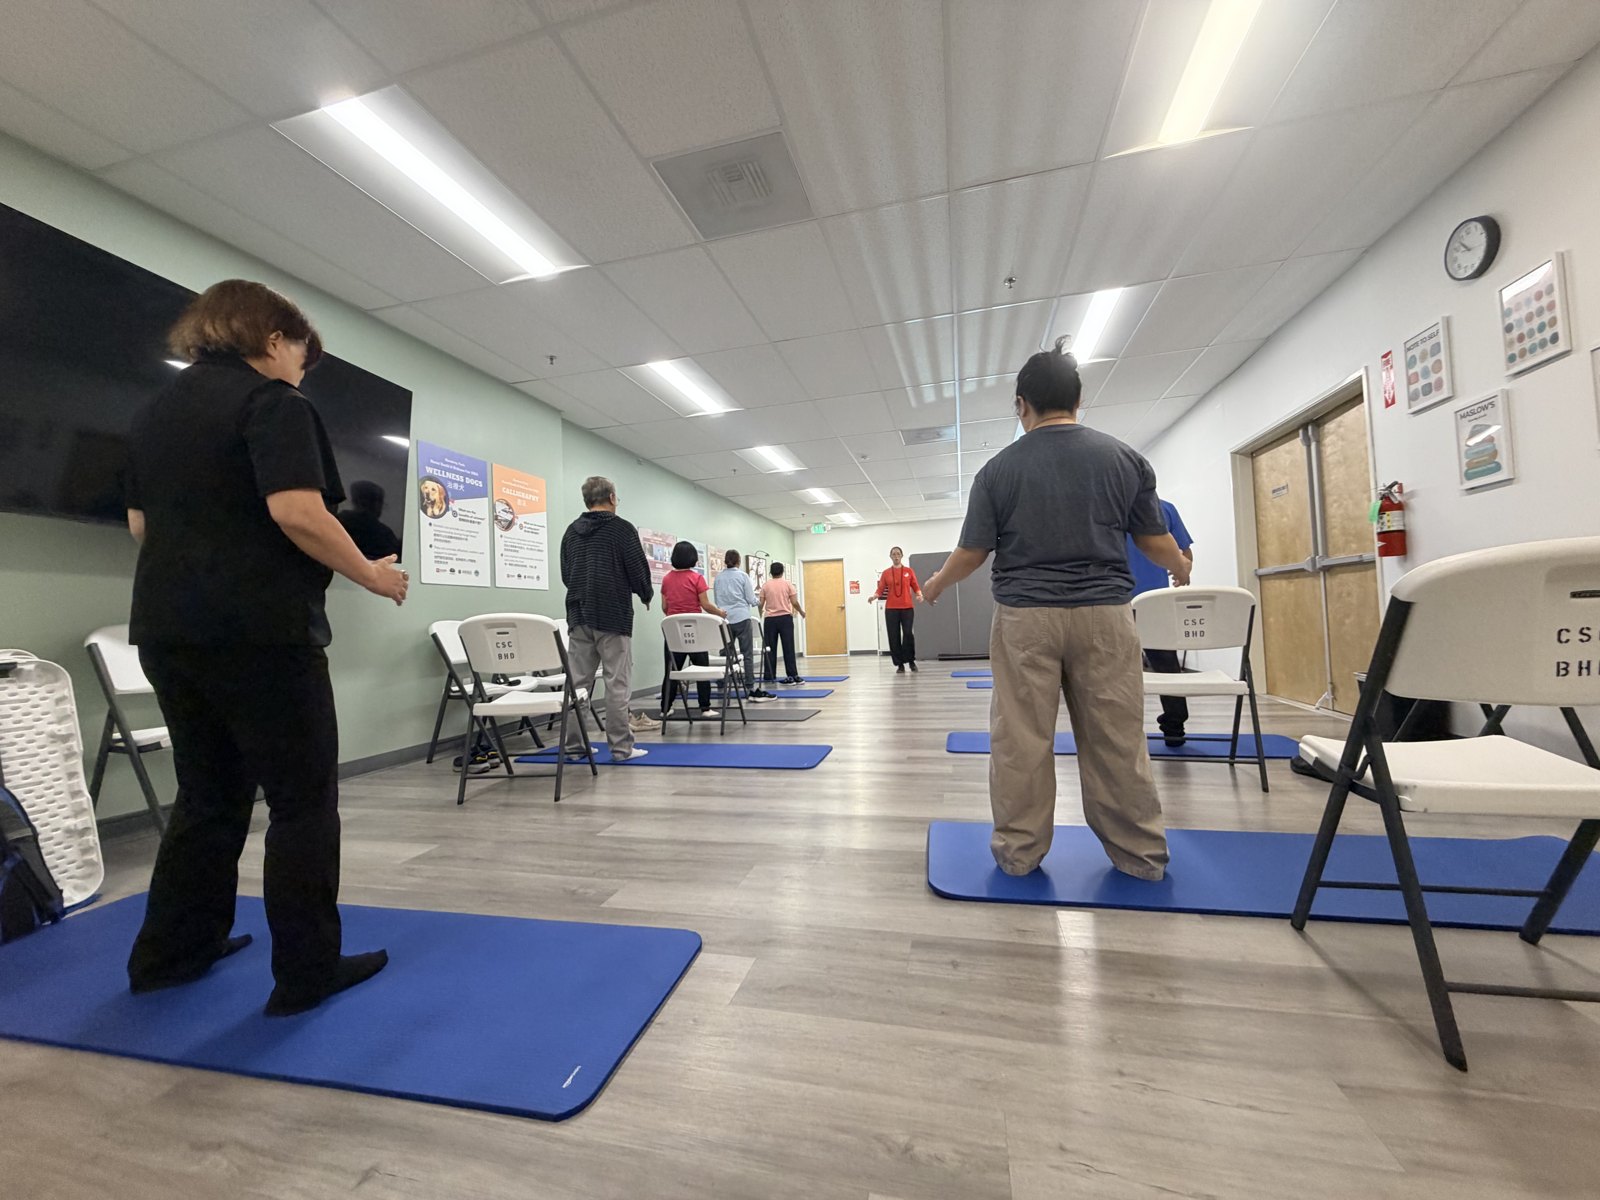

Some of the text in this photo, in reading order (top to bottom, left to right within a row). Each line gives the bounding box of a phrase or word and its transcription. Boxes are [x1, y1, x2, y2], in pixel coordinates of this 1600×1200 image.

[1406, 329, 1440, 352] NOTE TO SELF
[1459, 400, 1496, 420] MASLOW'S
[425, 465, 464, 483] WELLNESS
[465, 477, 483, 488] DOGS
[1183, 618, 1205, 626] CSC
[1184, 630, 1205, 638] BHD
[1556, 626, 1600, 645] CS
[497, 652, 515, 660] BHD
[1555, 659, 1600, 677] BH
